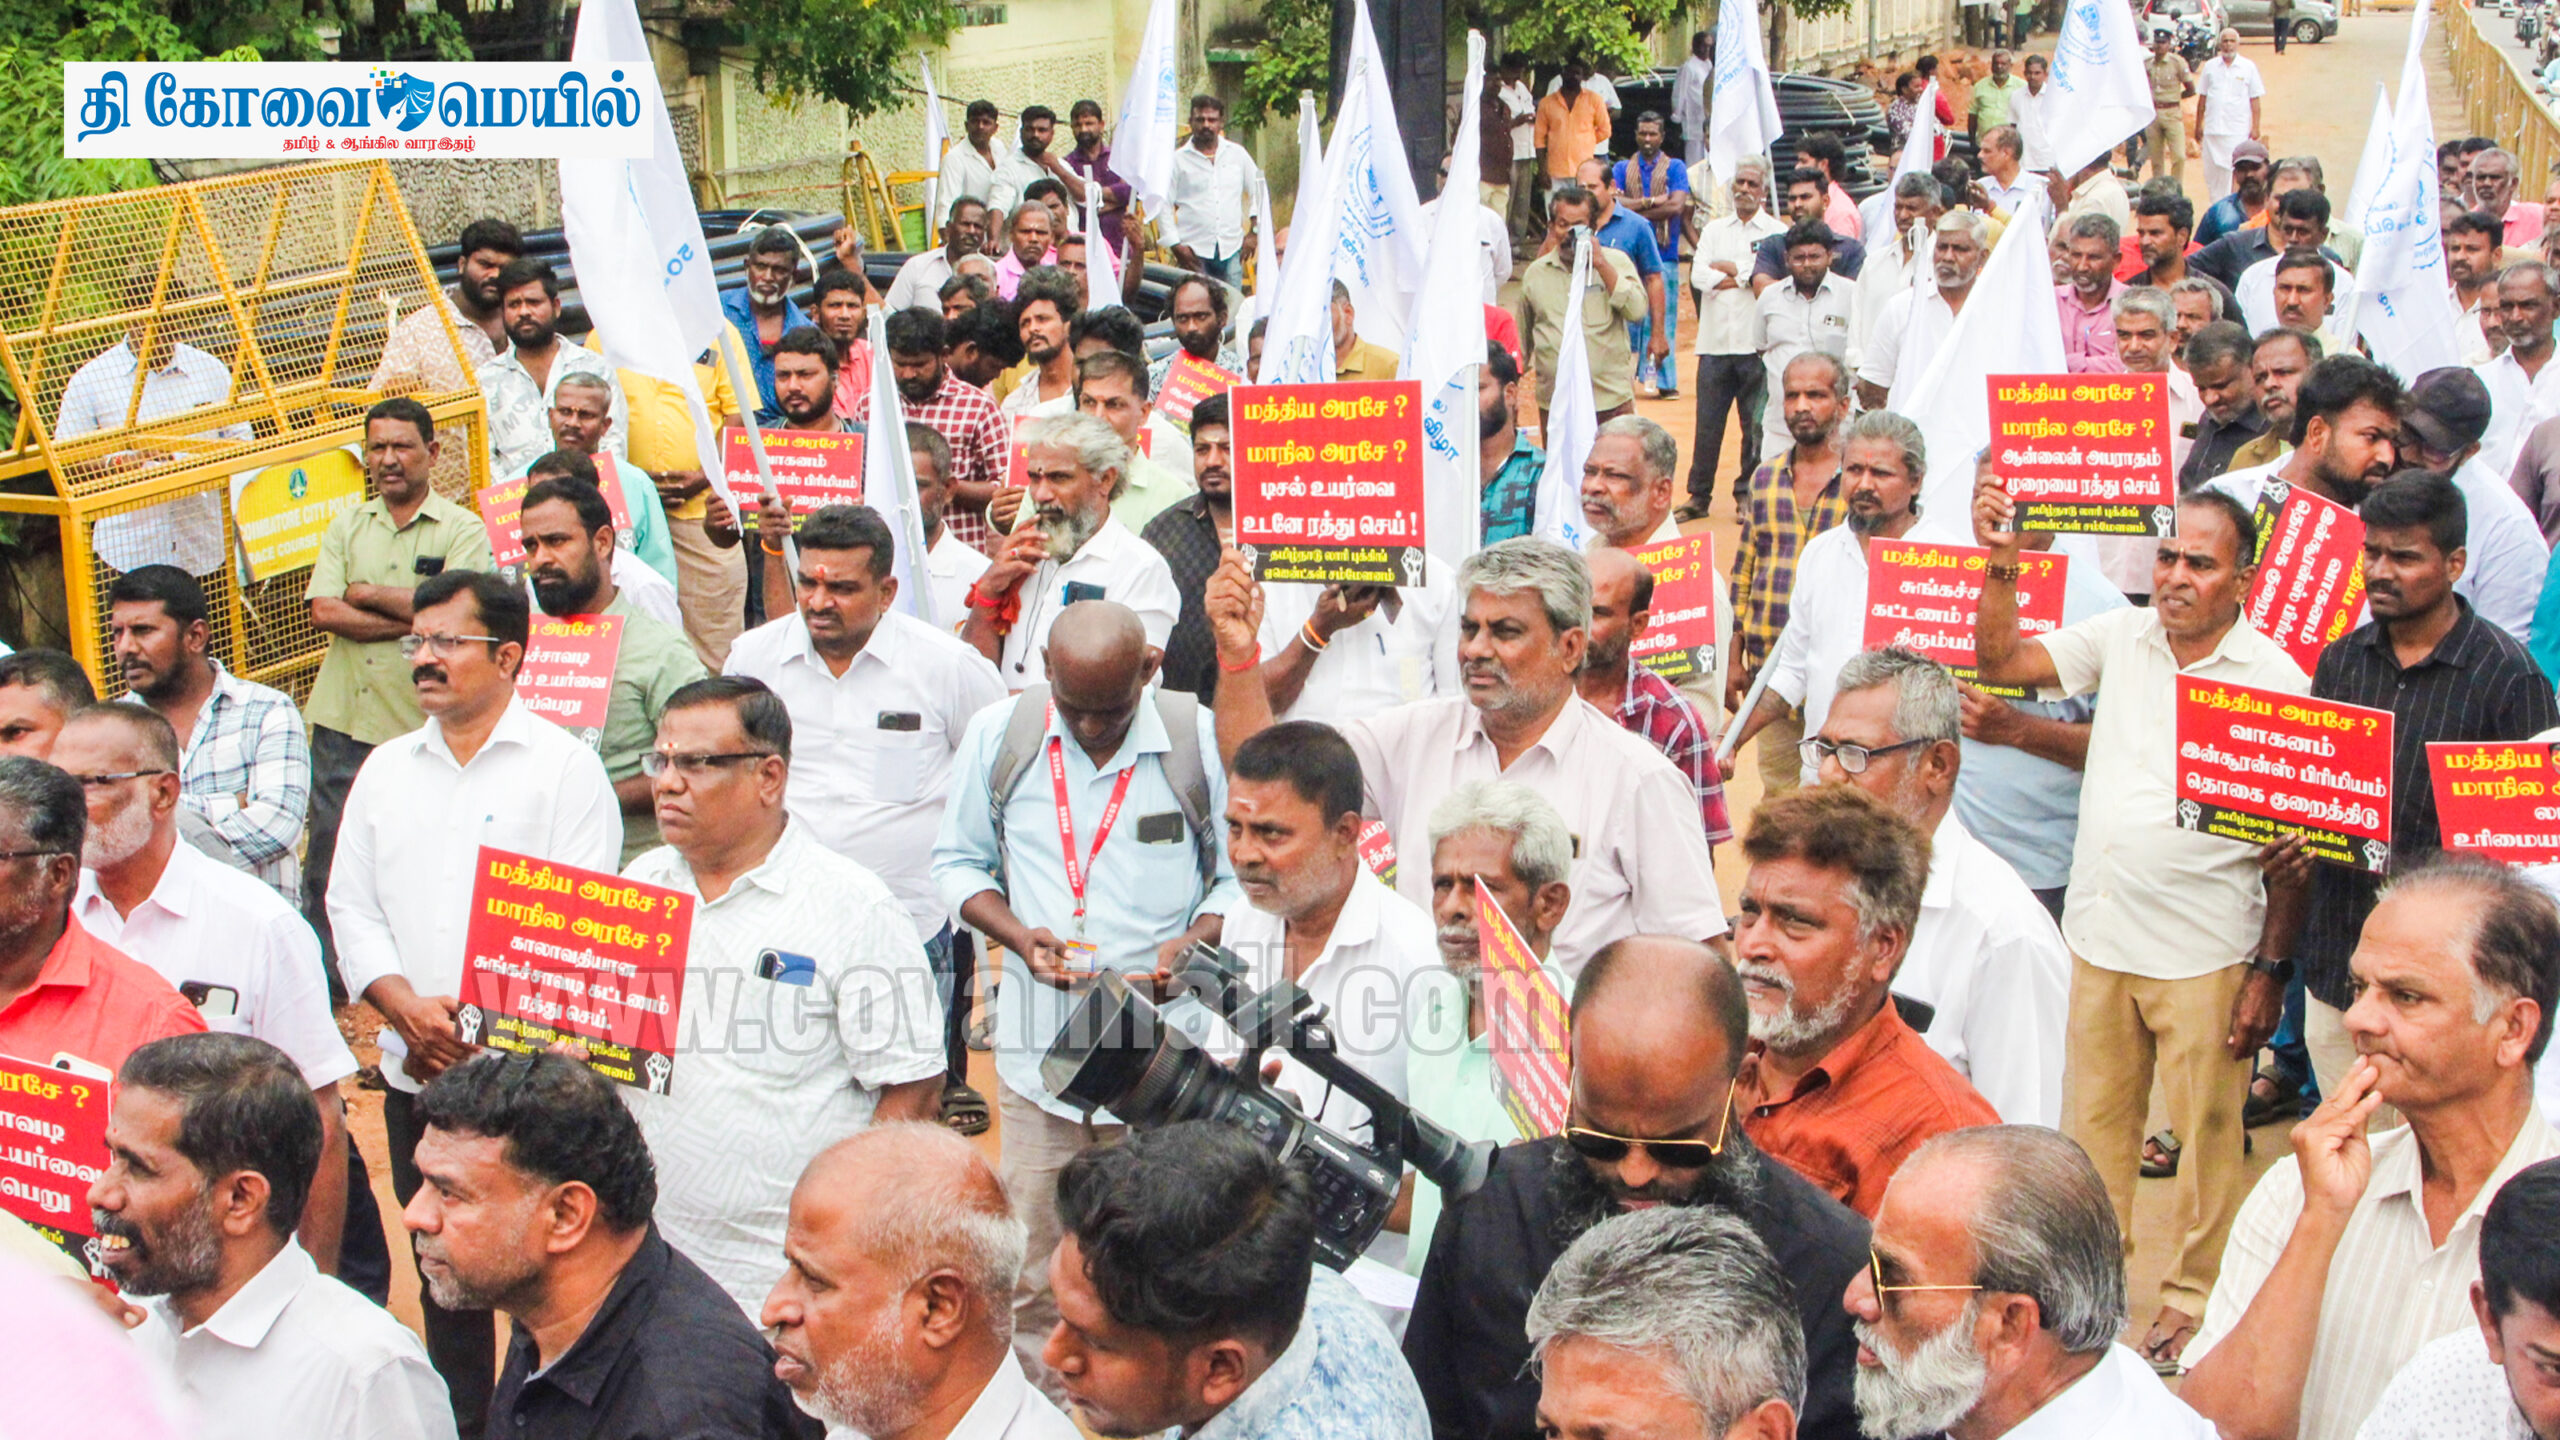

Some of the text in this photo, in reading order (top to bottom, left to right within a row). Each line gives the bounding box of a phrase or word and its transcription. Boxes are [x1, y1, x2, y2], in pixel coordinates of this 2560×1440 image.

[1999, 381, 2155, 404] மத்திய அரசே ?
[1244, 396, 1316, 424] மத்திய
[1320, 396, 1389, 420] அரசே
[1394, 395, 1409, 418] ?
[2002, 417, 2155, 439] மாநில அரசே ?
[791, 436, 840, 449] அரசே
[1247, 439, 1408, 467] மாநில அரசே ?
[2001, 446, 2162, 469] ஆன்லைன் அபராதம்
[1310, 475, 1396, 499] உயர்வை
[2006, 473, 2160, 499] முறையை ரத்து செய்
[1242, 510, 1418, 540] உடனே ரத்து செய் !
[1881, 546, 1958, 569] மத்திய
[2039, 560, 2054, 577] ?
[1654, 567, 1686, 586] ரசே
[1871, 603, 1962, 625] கட்டணம்
[540, 621, 596, 637] அரசே
[535, 670, 608, 689] உயர்வை
[2190, 688, 2378, 736] மத்திய அரசே ?
[2229, 724, 2336, 757] வாகனம்
[1052, 751, 1062, 779] PRESS
[2180, 741, 2387, 797] இன்சூரன்ஸ் பிரிமியம்
[2445, 747, 2543, 772] மத்திய
[2186, 772, 2380, 830] தொகை குறைத்திடு
[2452, 776, 2545, 800] மாநில
[1059, 805, 1070, 834] PRESS
[1102, 803, 1118, 829] PRESS
[490, 859, 680, 919] மத்திய அரசே ?
[487, 897, 672, 956] மாநில அரசே ?
[510, 935, 638, 979] காலாவதியான
[473, 954, 670, 1016] சுங்கச்சாவடி கட்டணம்
[518, 993, 562, 1020] ரத்து
[0, 1069, 90, 1108] ரசே ?
